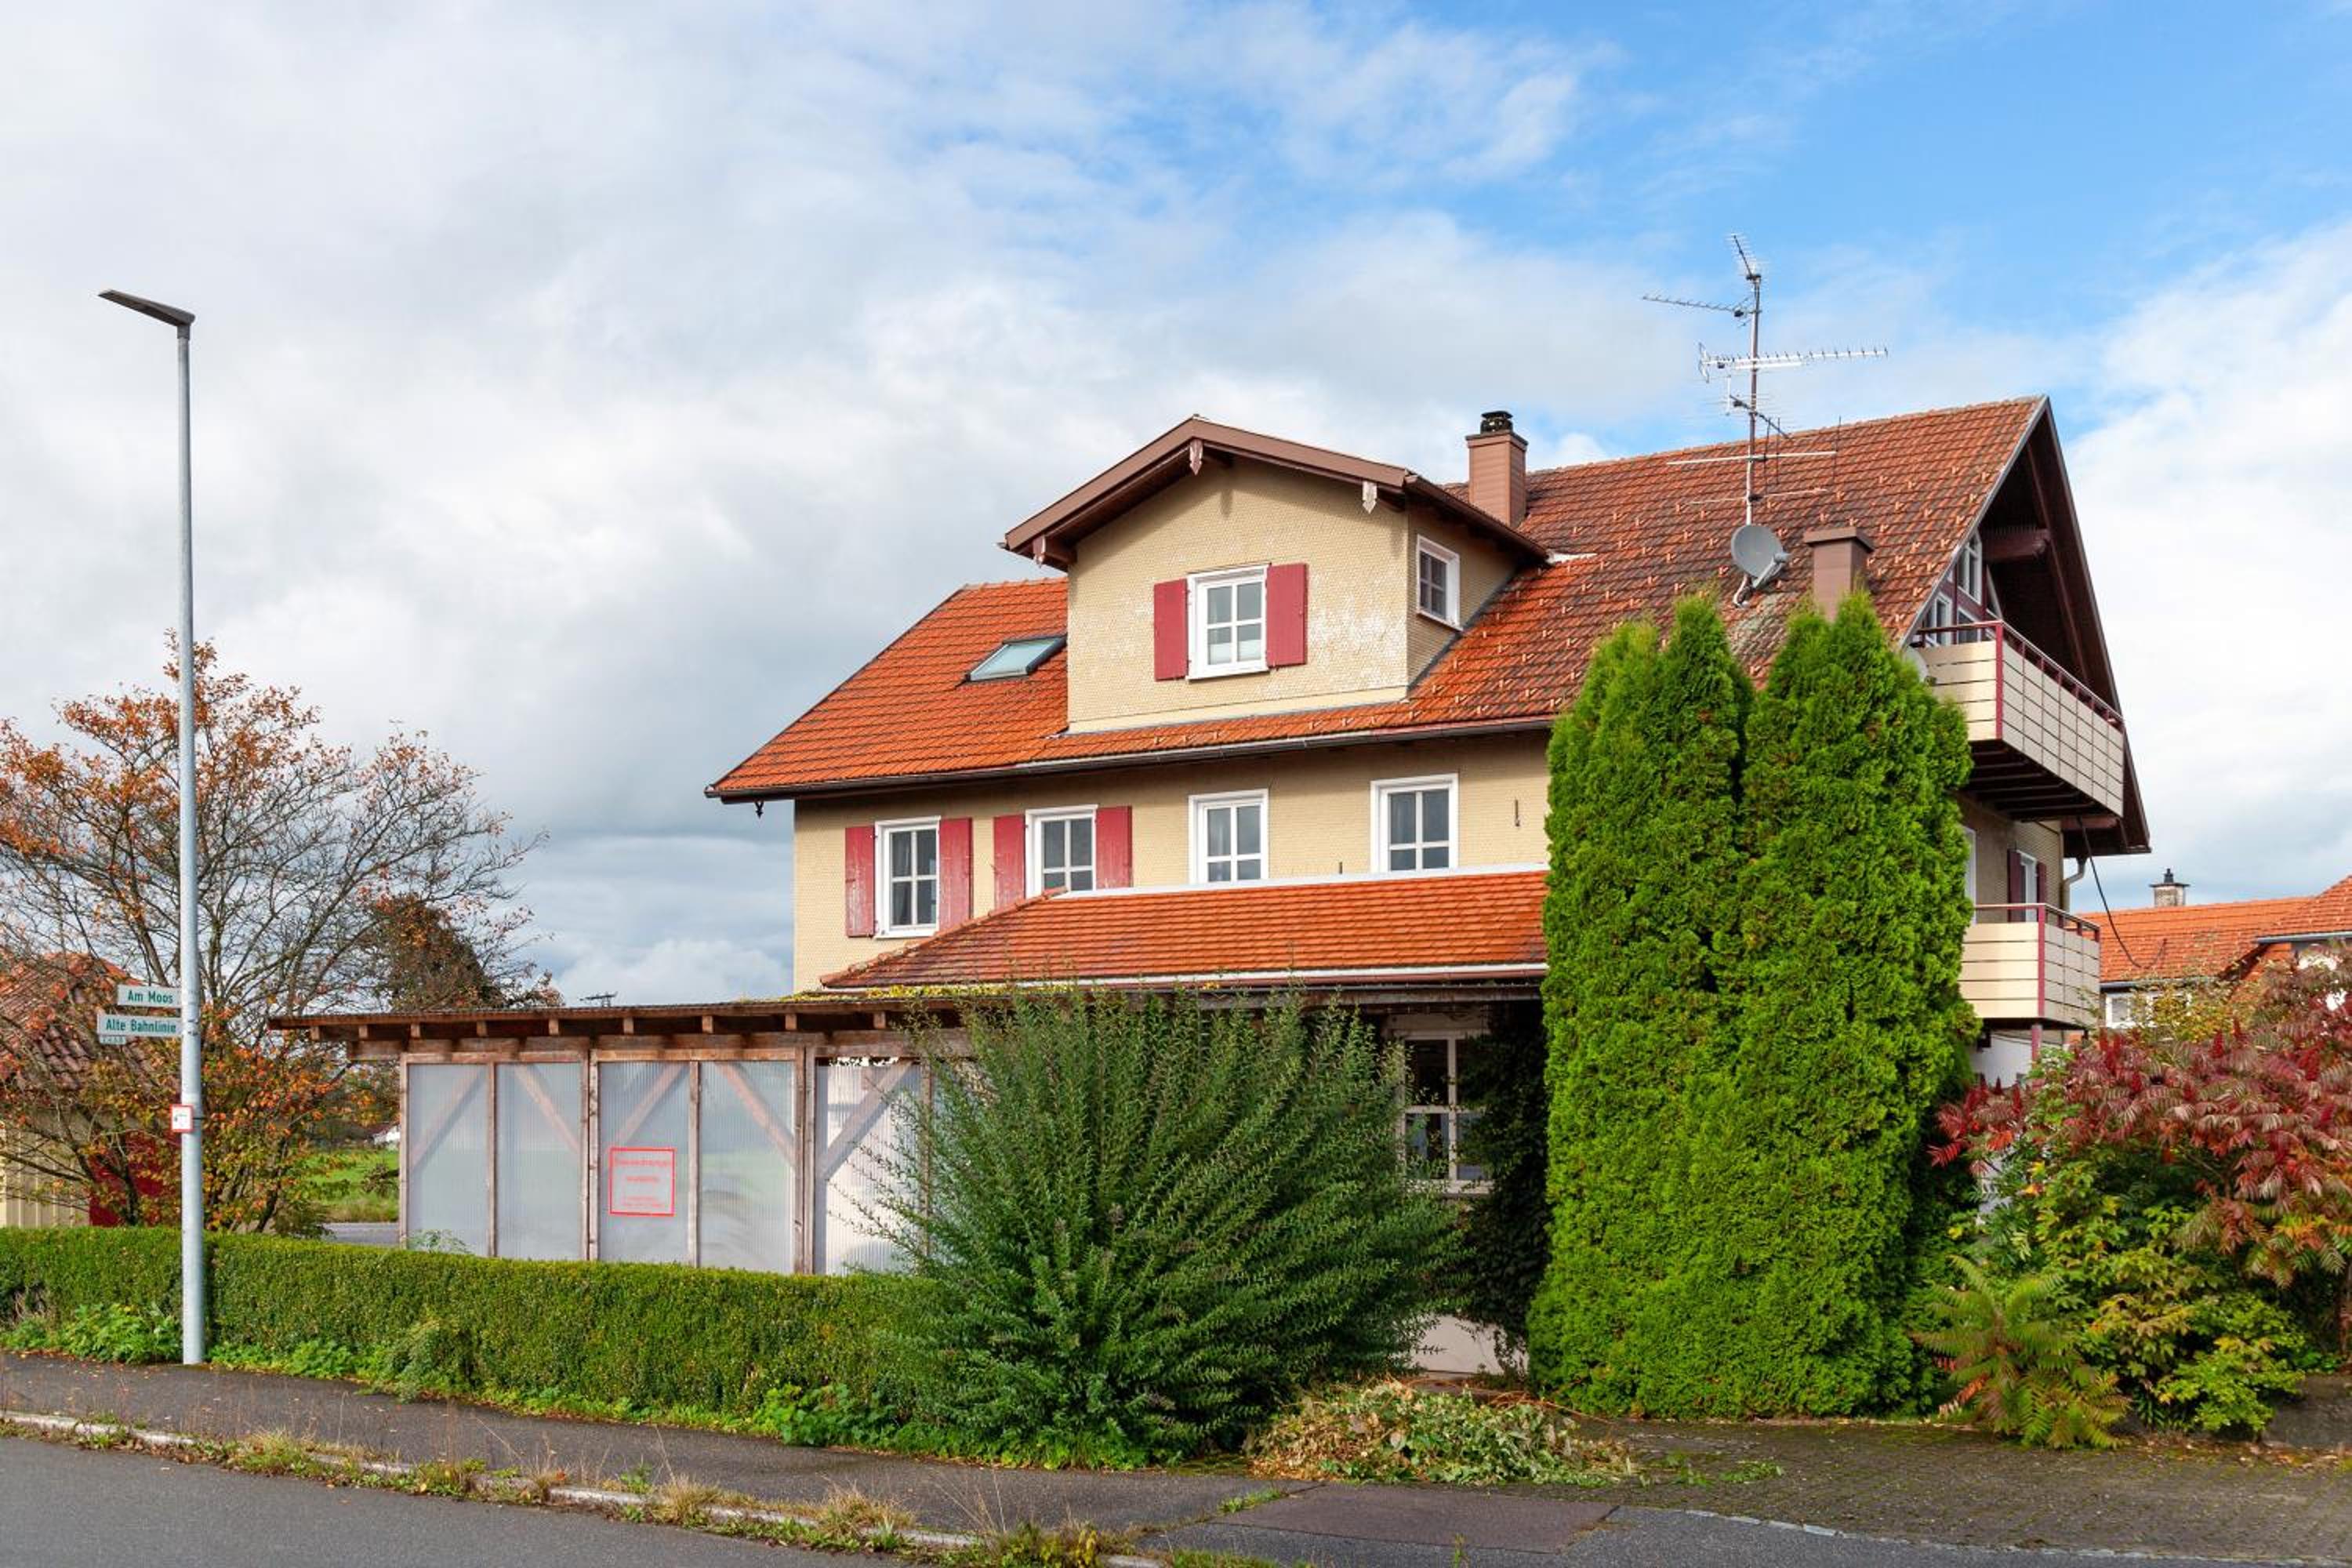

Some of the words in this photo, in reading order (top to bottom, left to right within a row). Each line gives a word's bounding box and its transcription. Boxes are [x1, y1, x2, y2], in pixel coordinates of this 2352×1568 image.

[128, 990, 143, 1003] Am
[148, 991, 173, 1004] Moos
[106, 1018, 126, 1031] Alte
[131, 1019, 176, 1033] Bahnlinie
